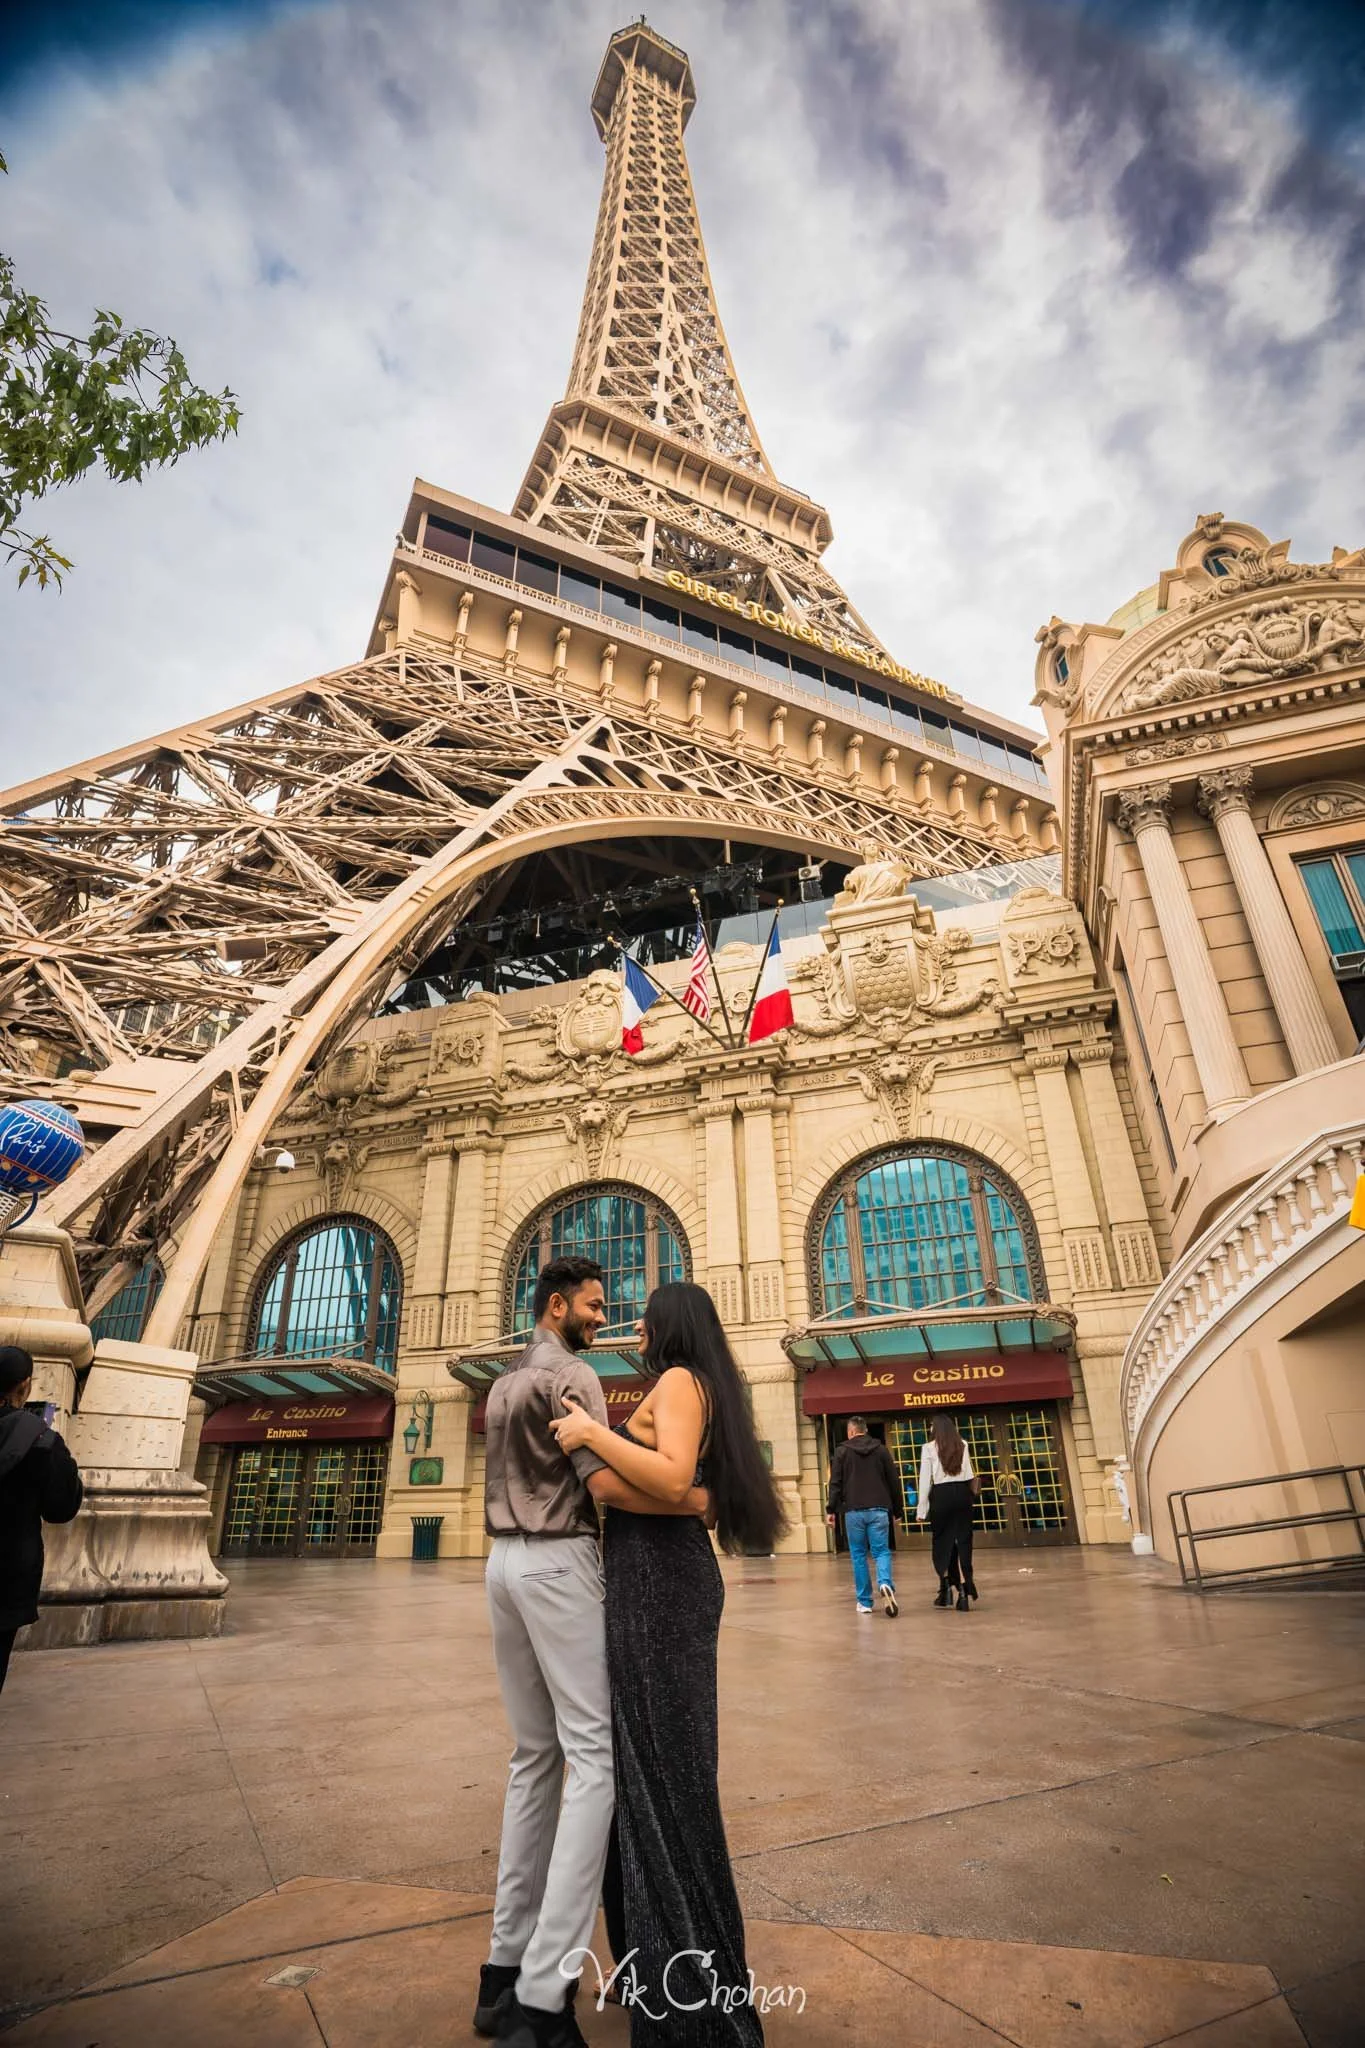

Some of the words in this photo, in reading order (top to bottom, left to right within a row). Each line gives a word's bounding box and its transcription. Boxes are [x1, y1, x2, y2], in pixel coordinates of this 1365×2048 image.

[665, 570, 744, 614] EIFFEL
[747, 600, 824, 646] TOWER
[832, 636, 950, 699] RESTAURANT
[0, 1121, 46, 1154] Paris
[863, 1371, 895, 1388] Le
[913, 1363, 1005, 1384] Casino
[603, 1389, 643, 1404] ino
[903, 1392, 966, 1407] Entrance
[248, 1408, 273, 1422] Le
[283, 1404, 347, 1420] Casino
[266, 1427, 308, 1440] Entrance
